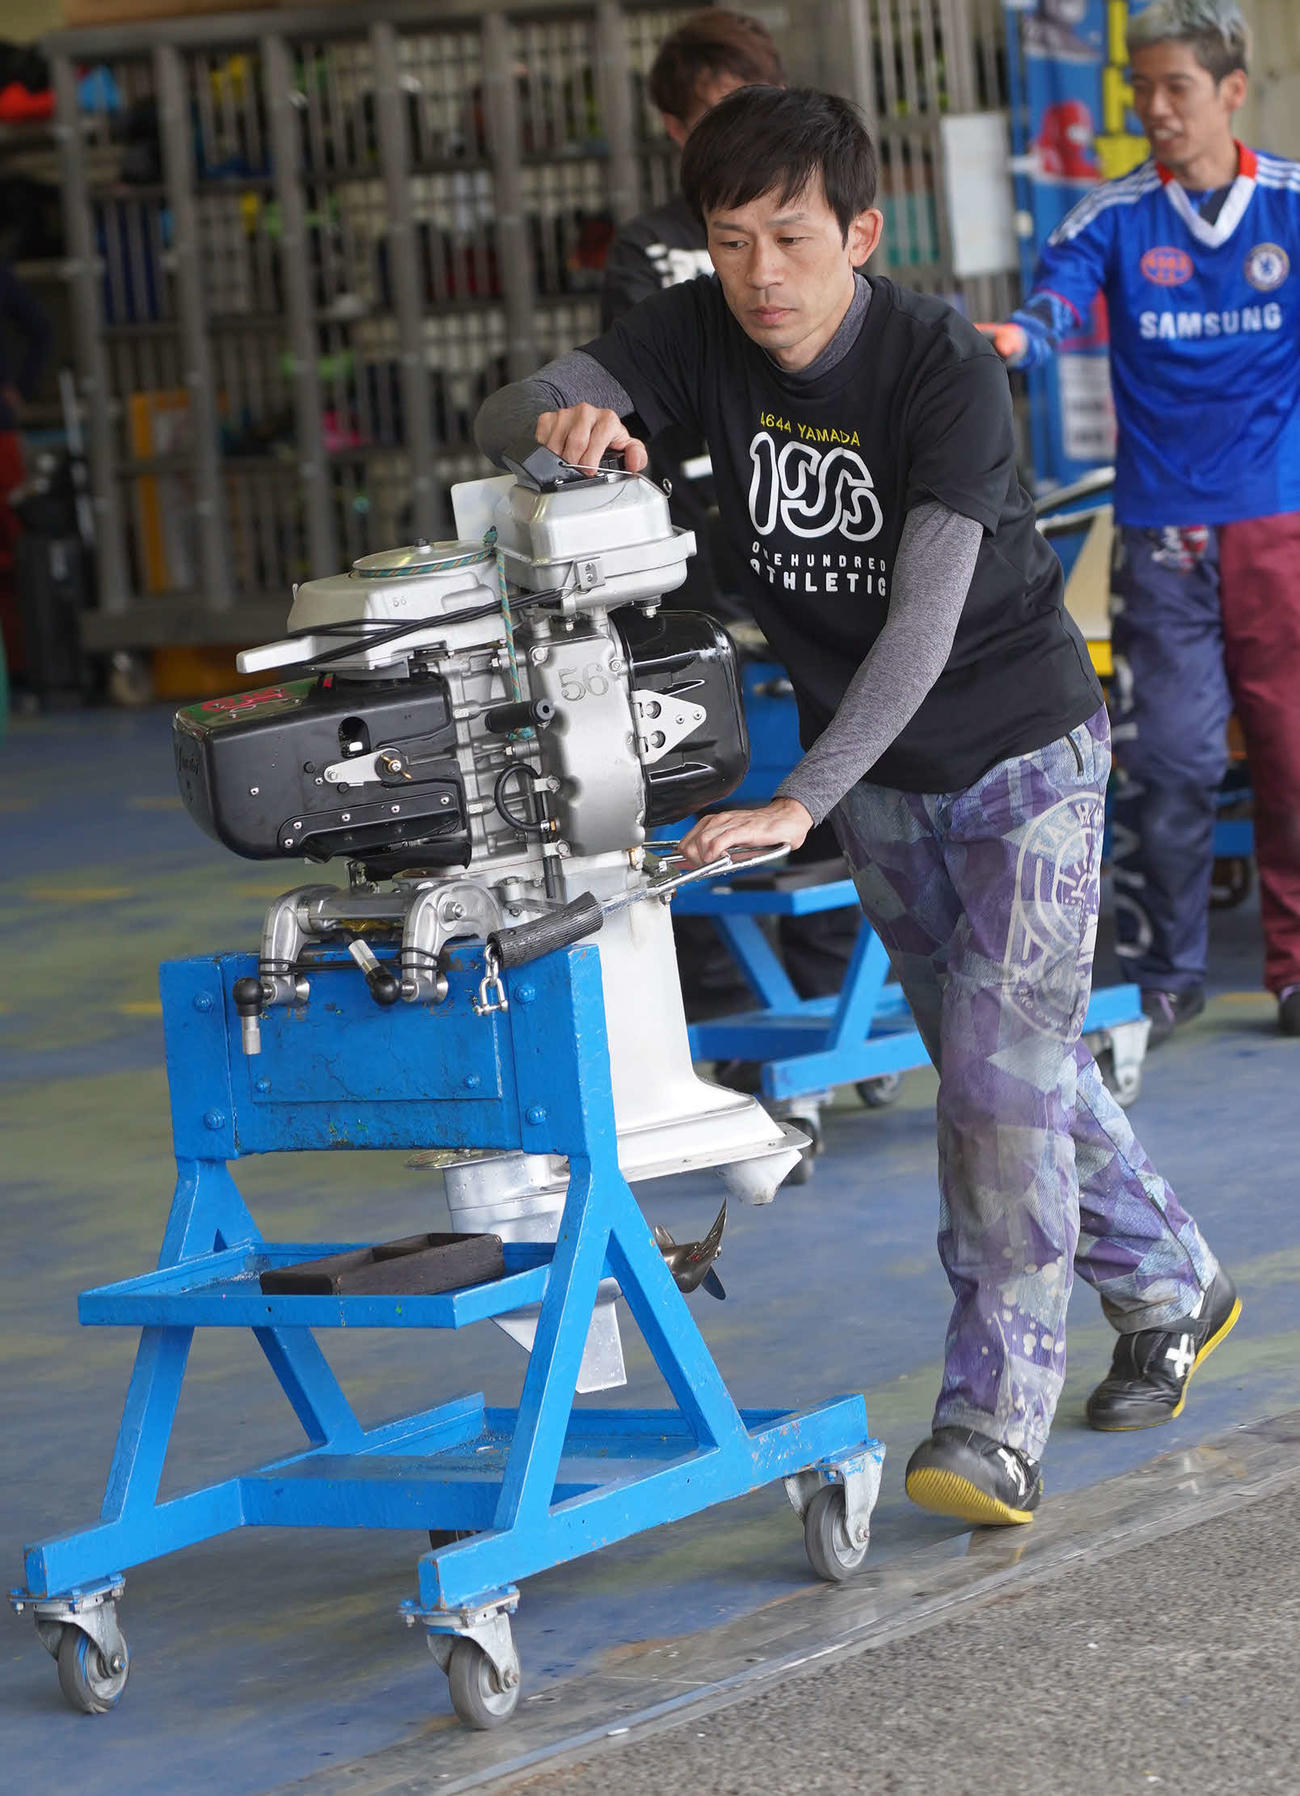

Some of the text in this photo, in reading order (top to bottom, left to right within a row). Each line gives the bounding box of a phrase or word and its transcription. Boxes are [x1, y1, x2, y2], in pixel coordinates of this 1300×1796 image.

[1139, 302, 1283, 340] SAMSUNG
[797, 422, 861, 447] YAMADA
[750, 558, 887, 597] ATHLETIC
[558, 662, 609, 700] 56
